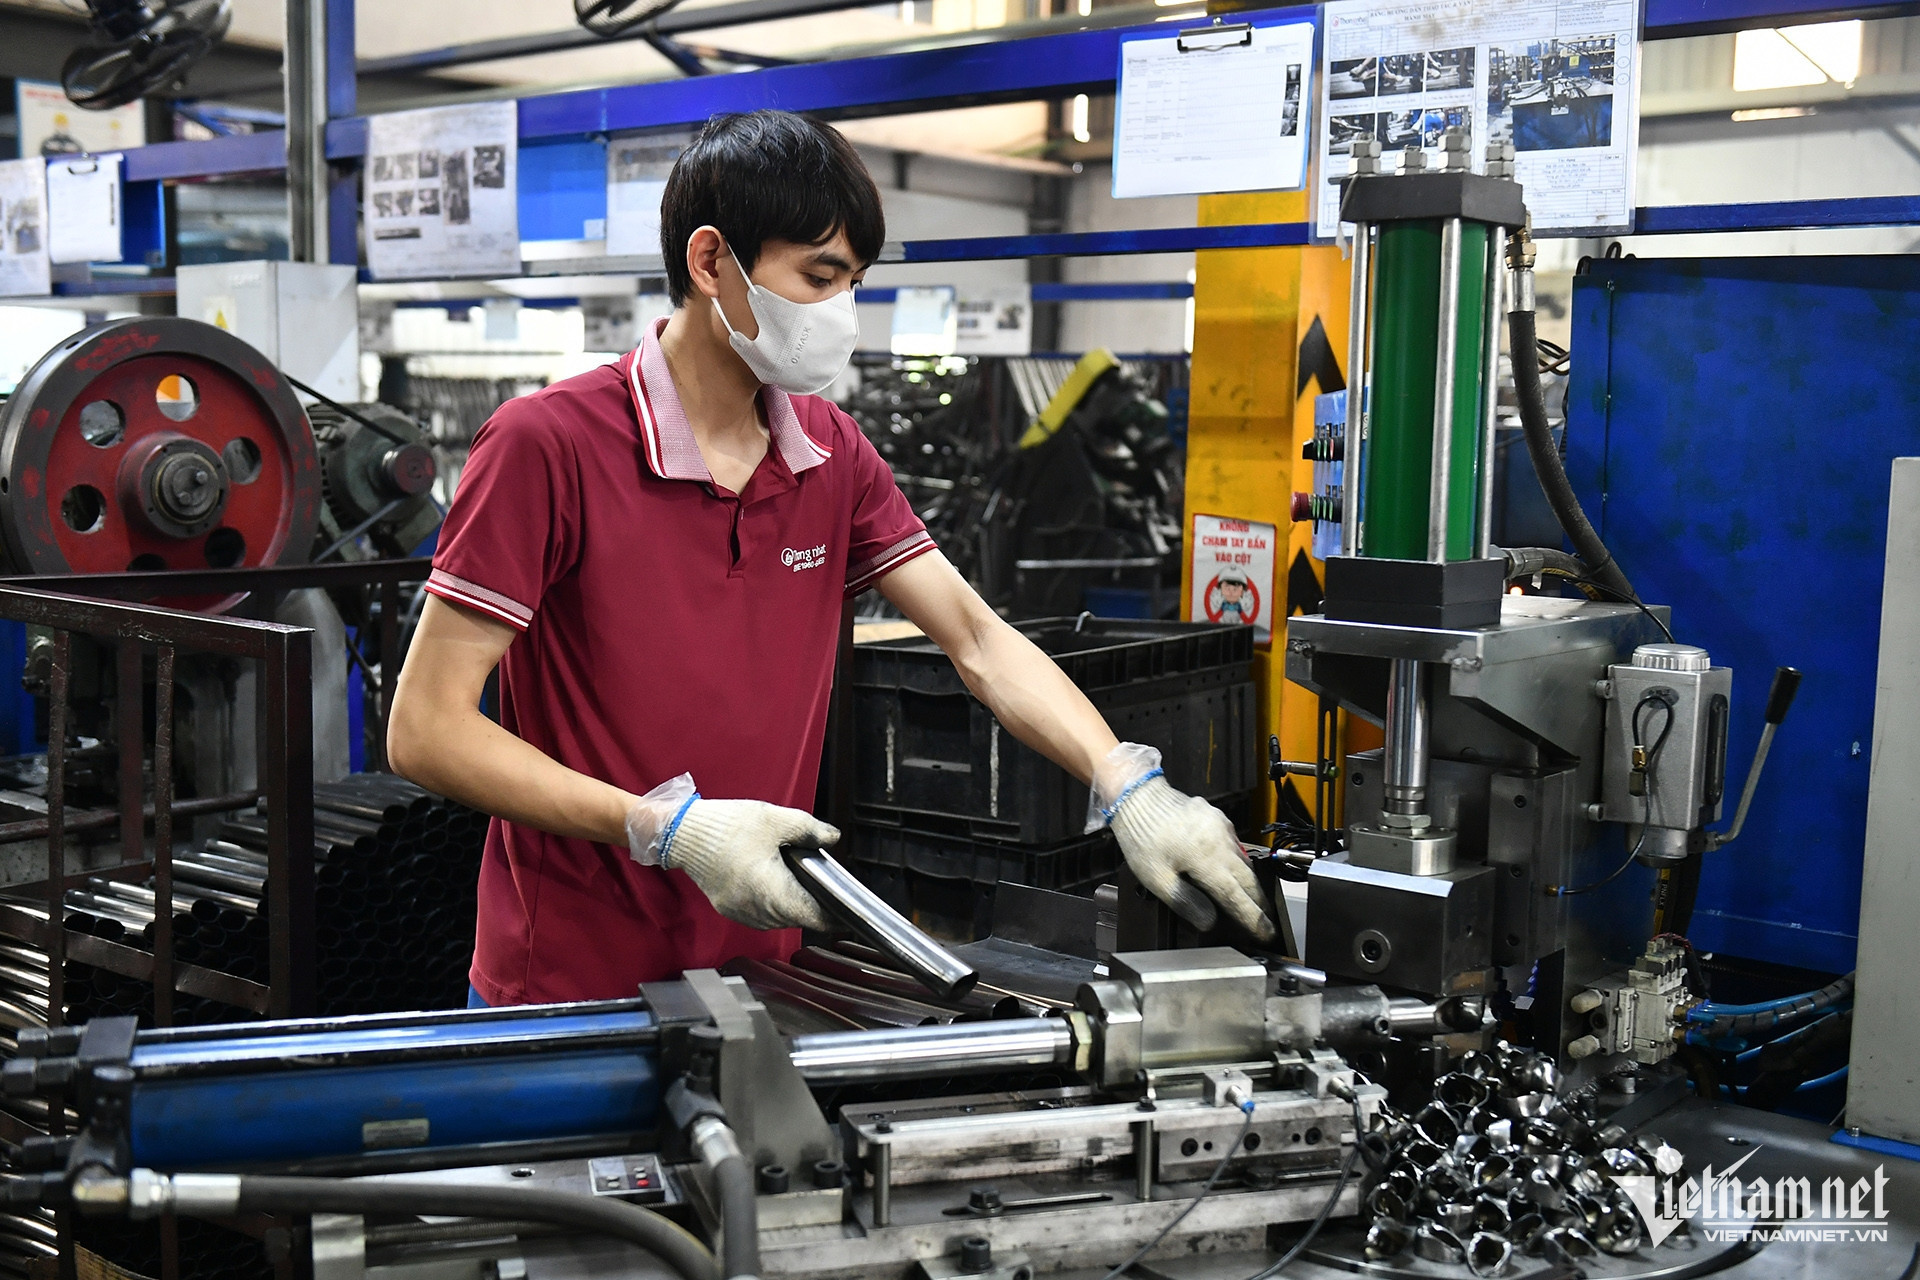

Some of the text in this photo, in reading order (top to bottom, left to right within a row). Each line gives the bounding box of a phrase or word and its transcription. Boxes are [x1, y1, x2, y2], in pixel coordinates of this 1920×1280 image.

[796, 327, 811, 352] MASK
[1219, 519, 1249, 532] KHÔNG
[1231, 537, 1245, 547] TAY
